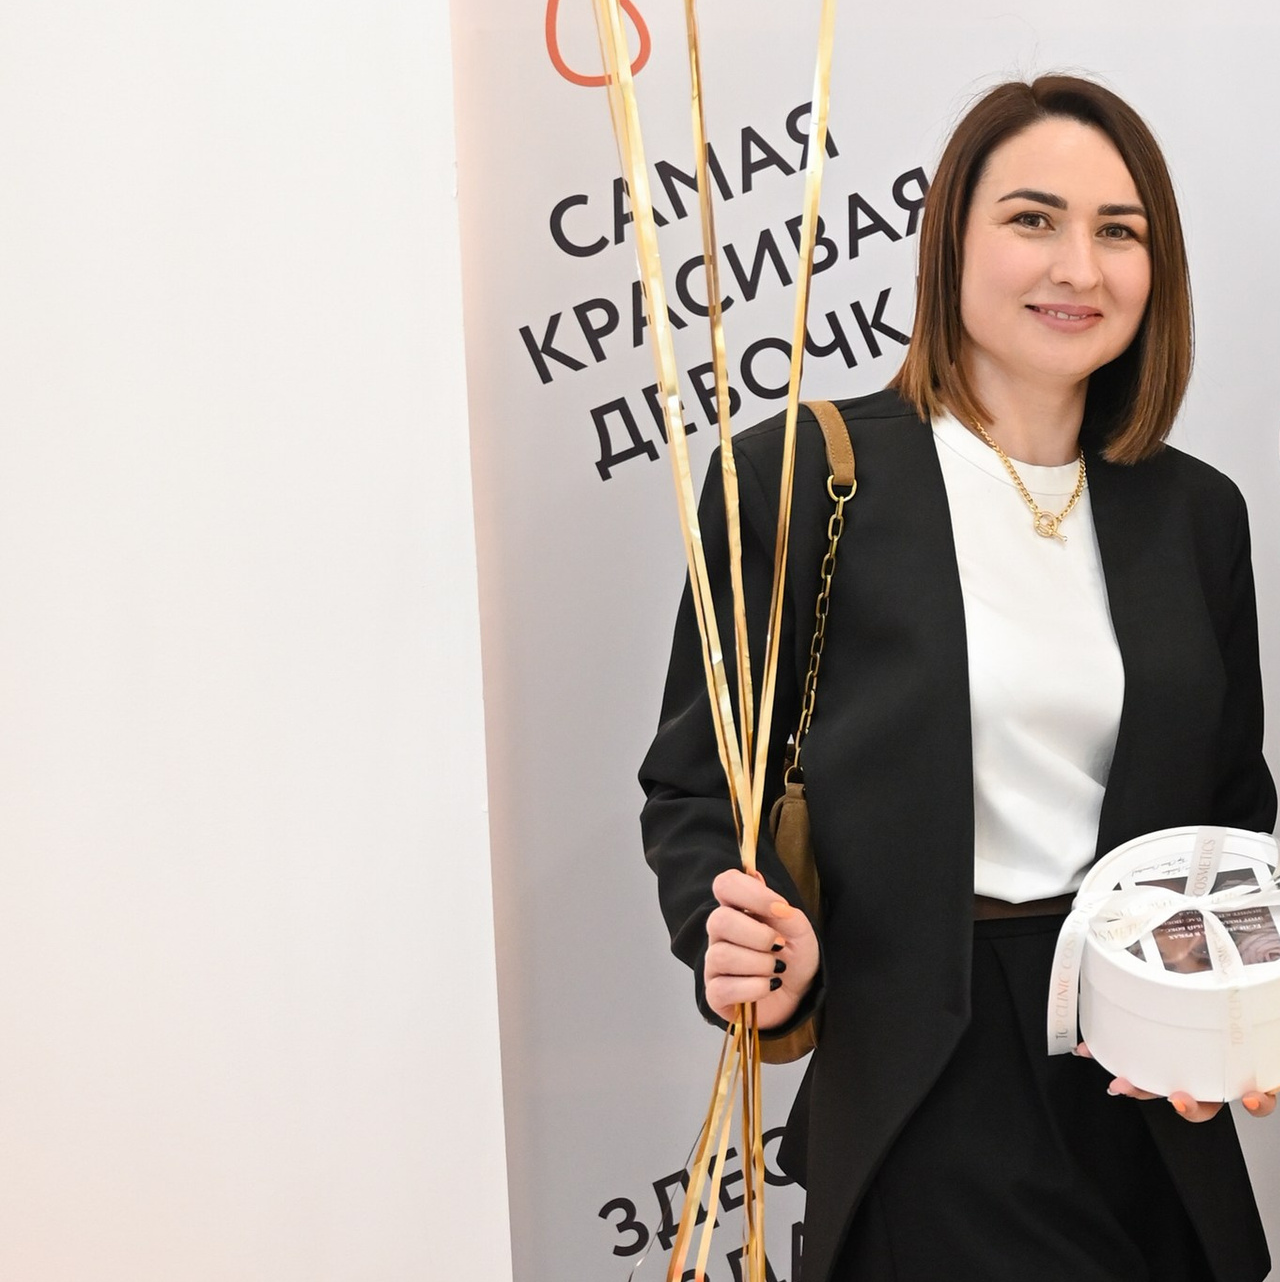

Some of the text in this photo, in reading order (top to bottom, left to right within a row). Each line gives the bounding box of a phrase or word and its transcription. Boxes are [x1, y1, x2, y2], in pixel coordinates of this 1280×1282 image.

[549, 101, 840, 258] САМАЯ
[519, 166, 931, 385] КРАСИВАЯ
[590, 287, 912, 482] ДЕВОЧК
[1192, 838, 1216, 897] COSMETICS
[1055, 972, 1072, 1017] CLINIC
[598, 1126, 797, 1257] ЗДЕС
